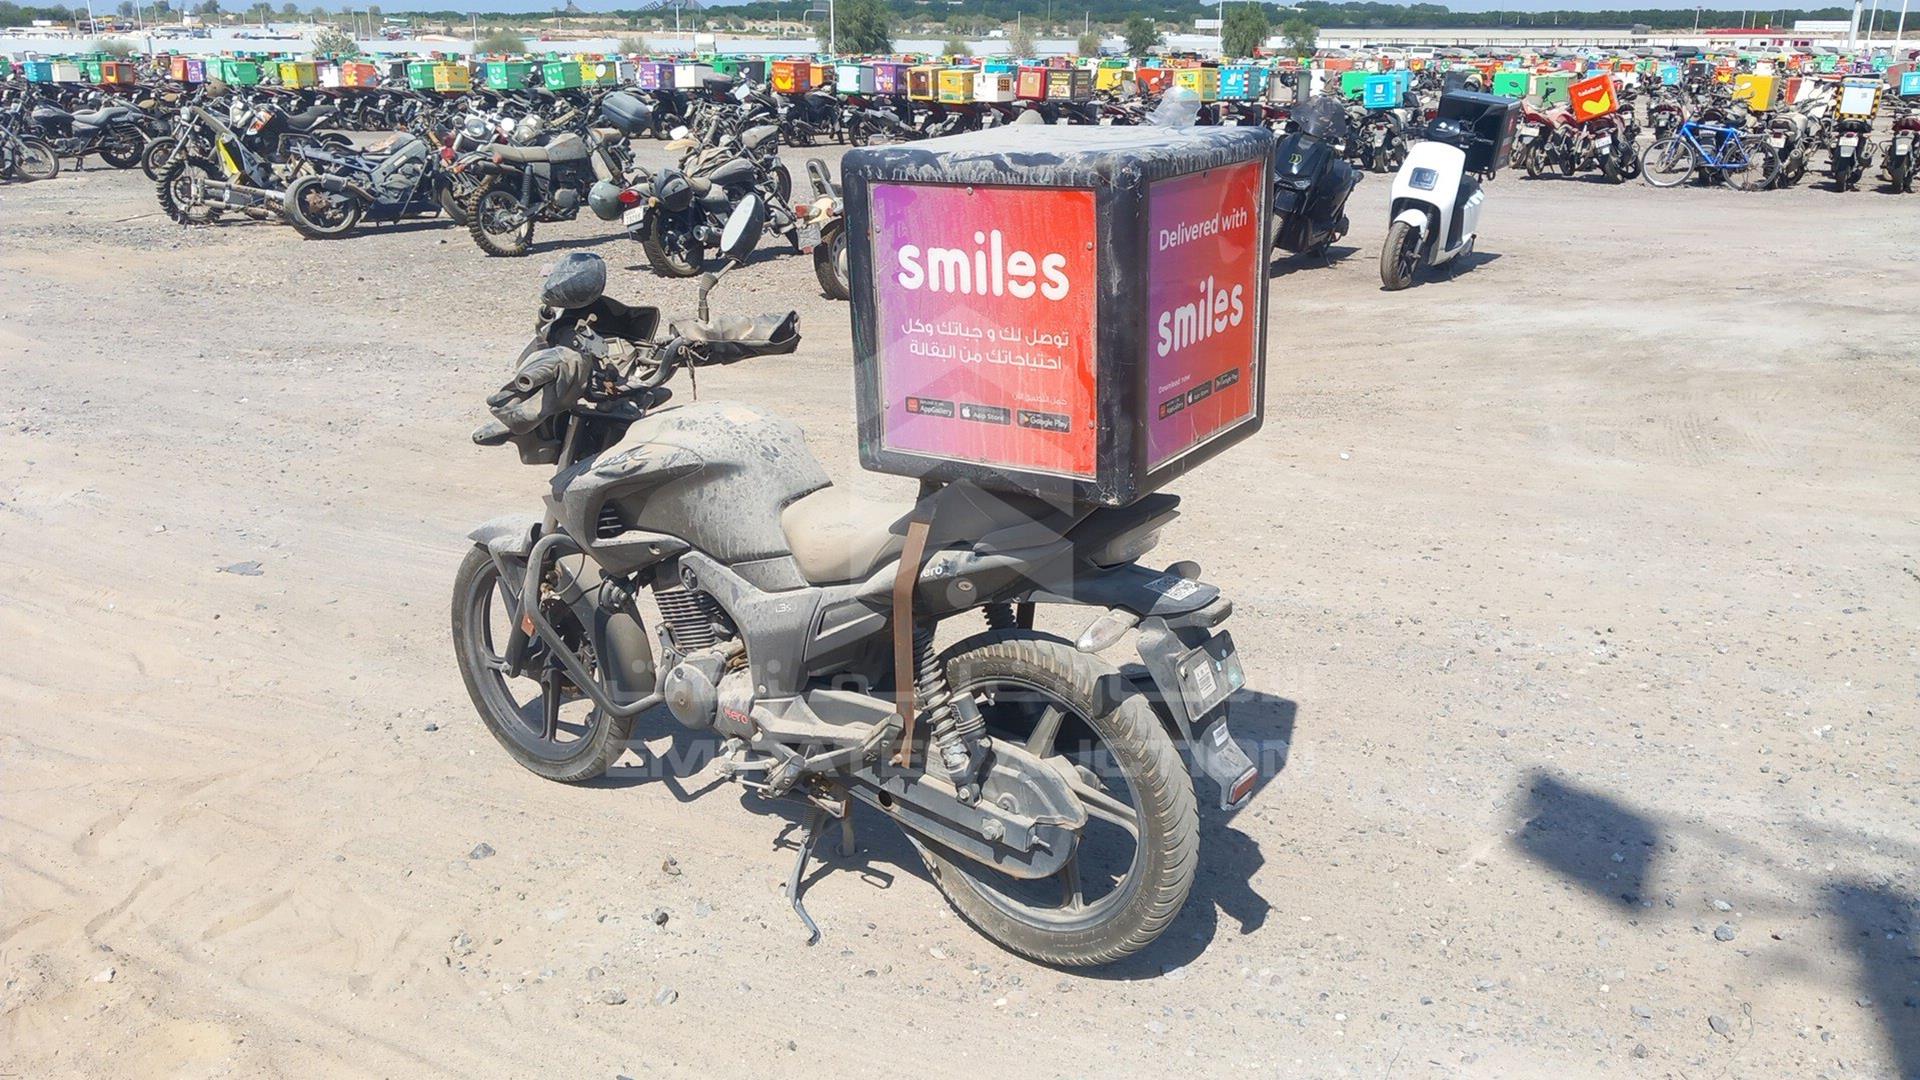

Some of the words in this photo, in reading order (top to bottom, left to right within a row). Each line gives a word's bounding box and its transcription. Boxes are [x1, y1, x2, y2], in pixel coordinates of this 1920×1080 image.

[1160, 212, 1219, 251] Delivered
[1221, 206, 1248, 231] with
[898, 229, 1070, 301] smiles
[1157, 275, 1243, 357] smiles
[901, 318, 933, 337] وكل
[1000, 327, 1021, 342] لك
[910, 339, 956, 362] البقالة
[960, 346, 982, 363] من
[986, 349, 1062, 372] احتياجاتك
[920, 406, 952, 417] AppGallery
[972, 412, 986, 420] App
[987, 413, 1004, 421] Store
[1030, 416, 1053, 428] Google
